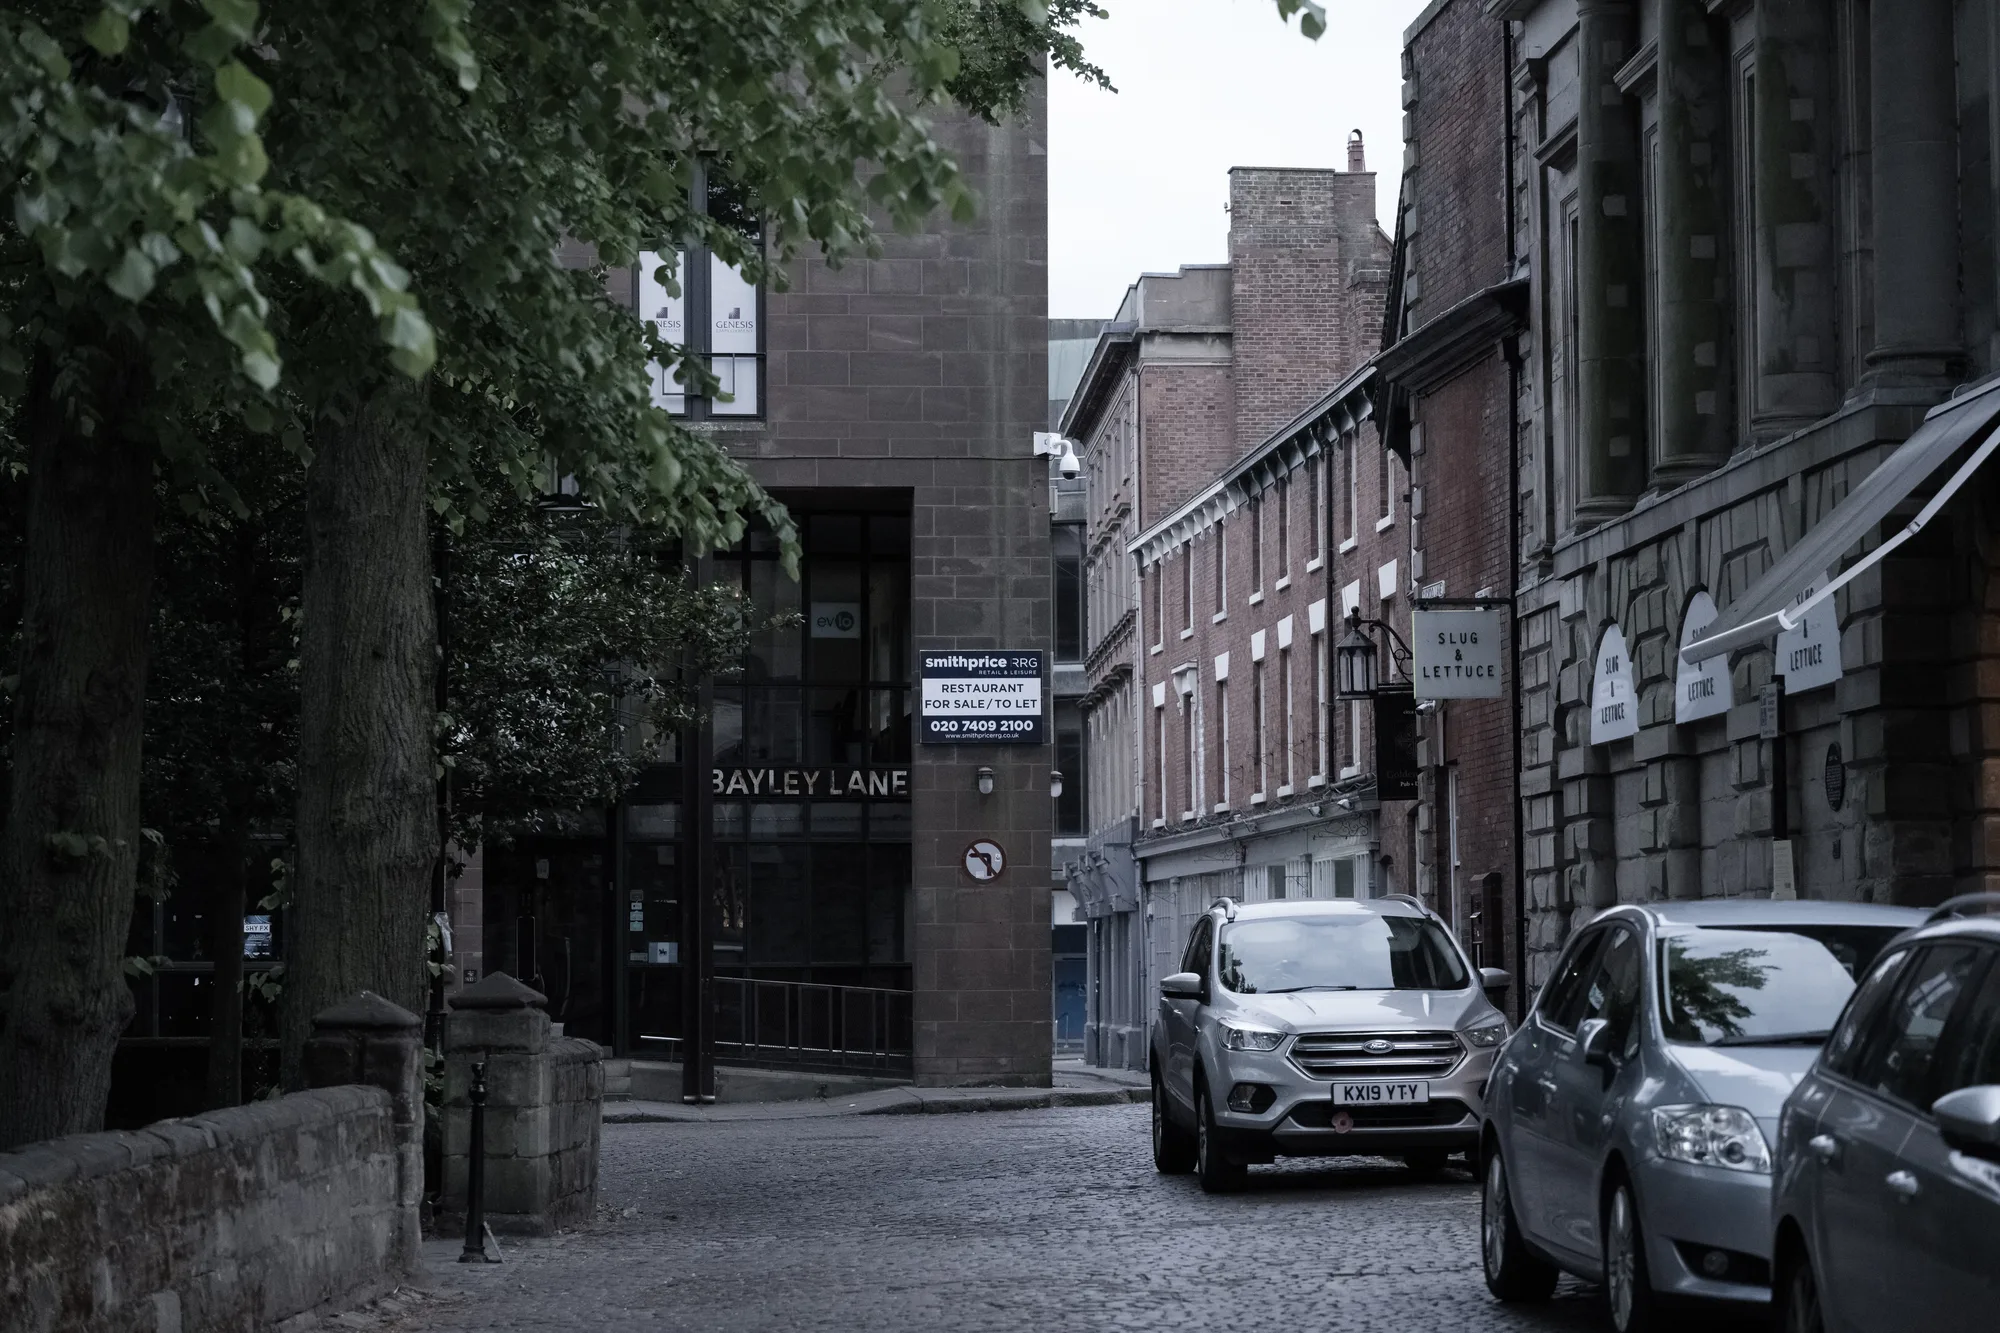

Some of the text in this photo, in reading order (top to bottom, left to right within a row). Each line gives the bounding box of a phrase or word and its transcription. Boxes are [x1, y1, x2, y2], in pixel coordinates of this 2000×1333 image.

[715, 321, 754, 329] GENESIS
[1438, 632, 1478, 644] SLUG
[1455, 649, 1462, 661] &
[1790, 643, 1822, 671] LETTUCE
[925, 656, 1038, 671] smithprice RRG
[1605, 655, 1619, 675] SLUG
[1423, 665, 1495, 678] LETTUCE
[941, 683, 1024, 693] RESTAURANT
[1687, 677, 1715, 702] LETTUCE
[925, 699, 951, 709] FOR
[1015, 699, 1038, 709] LET
[1601, 702, 1625, 725] LETTUCE
[930, 720, 1034, 731] 020 7409 2100
[712, 769, 908, 795] BAYLEY LANE
[1344, 1084, 1418, 1101] KX19 YTY
